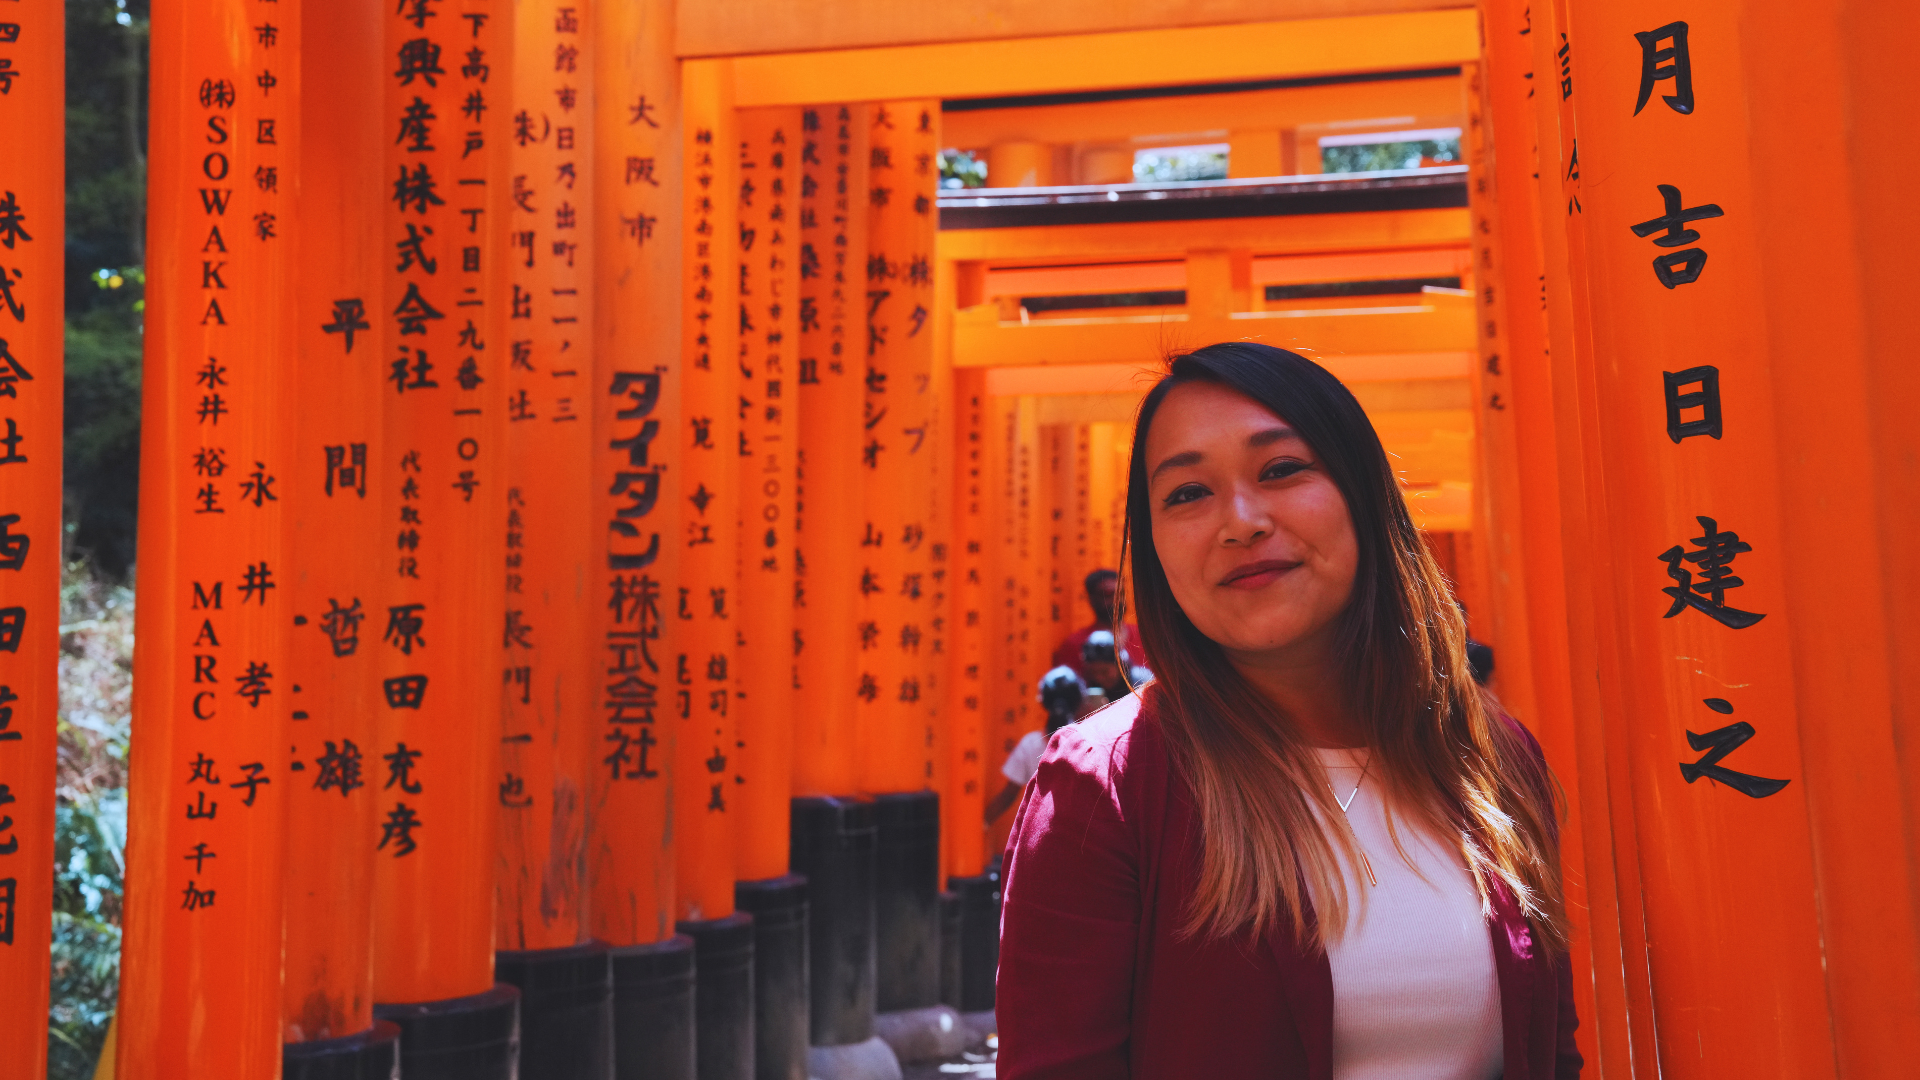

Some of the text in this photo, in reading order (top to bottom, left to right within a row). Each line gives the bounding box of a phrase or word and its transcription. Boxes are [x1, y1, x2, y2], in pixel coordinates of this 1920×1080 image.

[253, 0, 278, 241] 市中区領家
[197, 357, 228, 425] 永井
[397, 450, 421, 579] 代表取締役
[605, 95, 668, 780] 大阪市 ダイダン株式会社
[1630, 21, 1791, 799] 月吉日建之
[193, 582, 222, 720] MARC
[230, 462, 278, 807] 永井孝子
[313, 297, 371, 798] 平間哲雄
[186, 753, 220, 820] 丸山
[376, 603, 429, 858] 原田充彦
